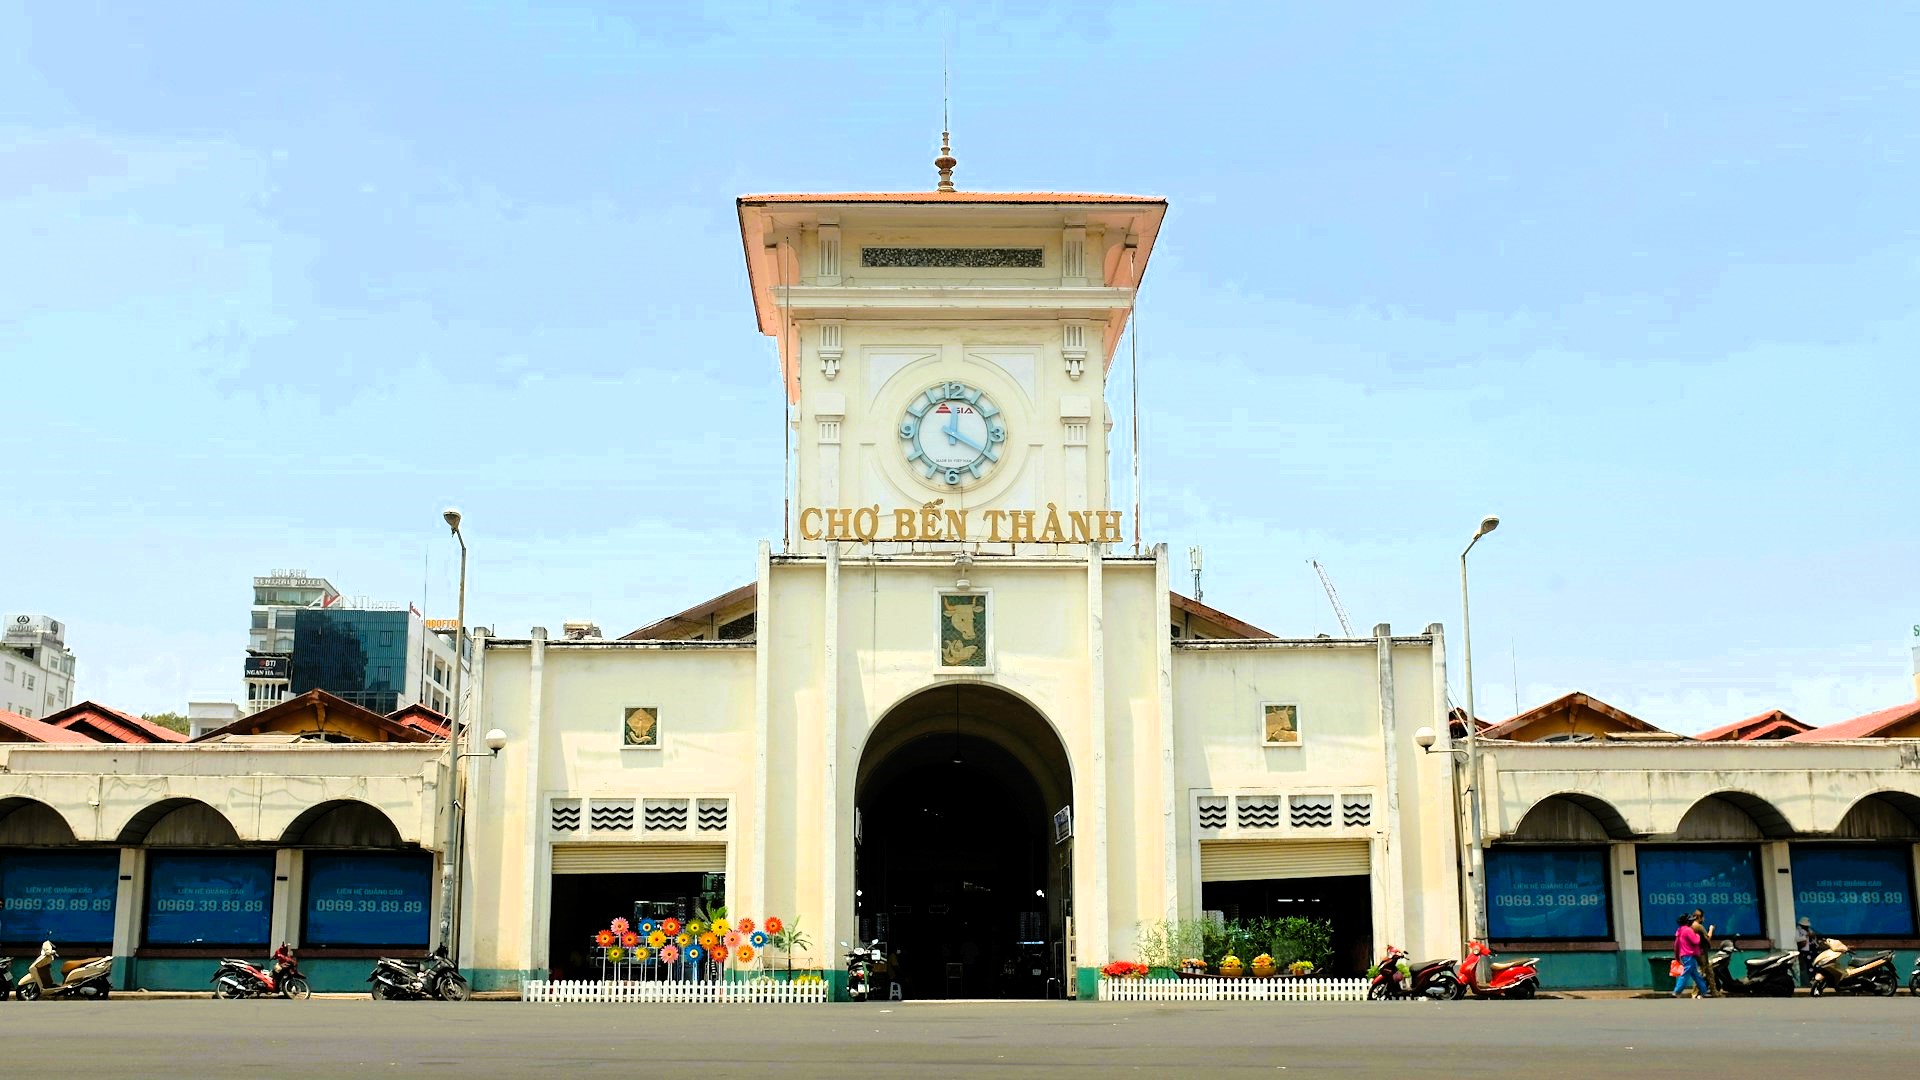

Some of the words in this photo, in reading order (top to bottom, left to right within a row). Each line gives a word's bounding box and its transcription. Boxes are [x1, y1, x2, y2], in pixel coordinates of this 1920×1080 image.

[942, 383, 965, 399] 12
[900, 424, 915, 439] 9
[989, 425, 1005, 442] 3
[944, 468, 960, 485] 6
[799, 503, 880, 545] CHỢ
[892, 498, 969, 542] BẾN
[982, 502, 1124, 543] THÀNH
[270, 568, 307, 578] GOLDEN
[1913, 624, 1920, 637] S
[1495, 894, 1598, 907] 0969.39.89.89
[1649, 892, 1751, 905] 0969.39.89.89
[1799, 891, 1903, 904] 0969.39.89.89
[4, 898, 112, 911] 0969.39.89.89
[158, 899, 263, 912] 0969.39.89.89
[316, 899, 422, 913] 0969.39.89.89
